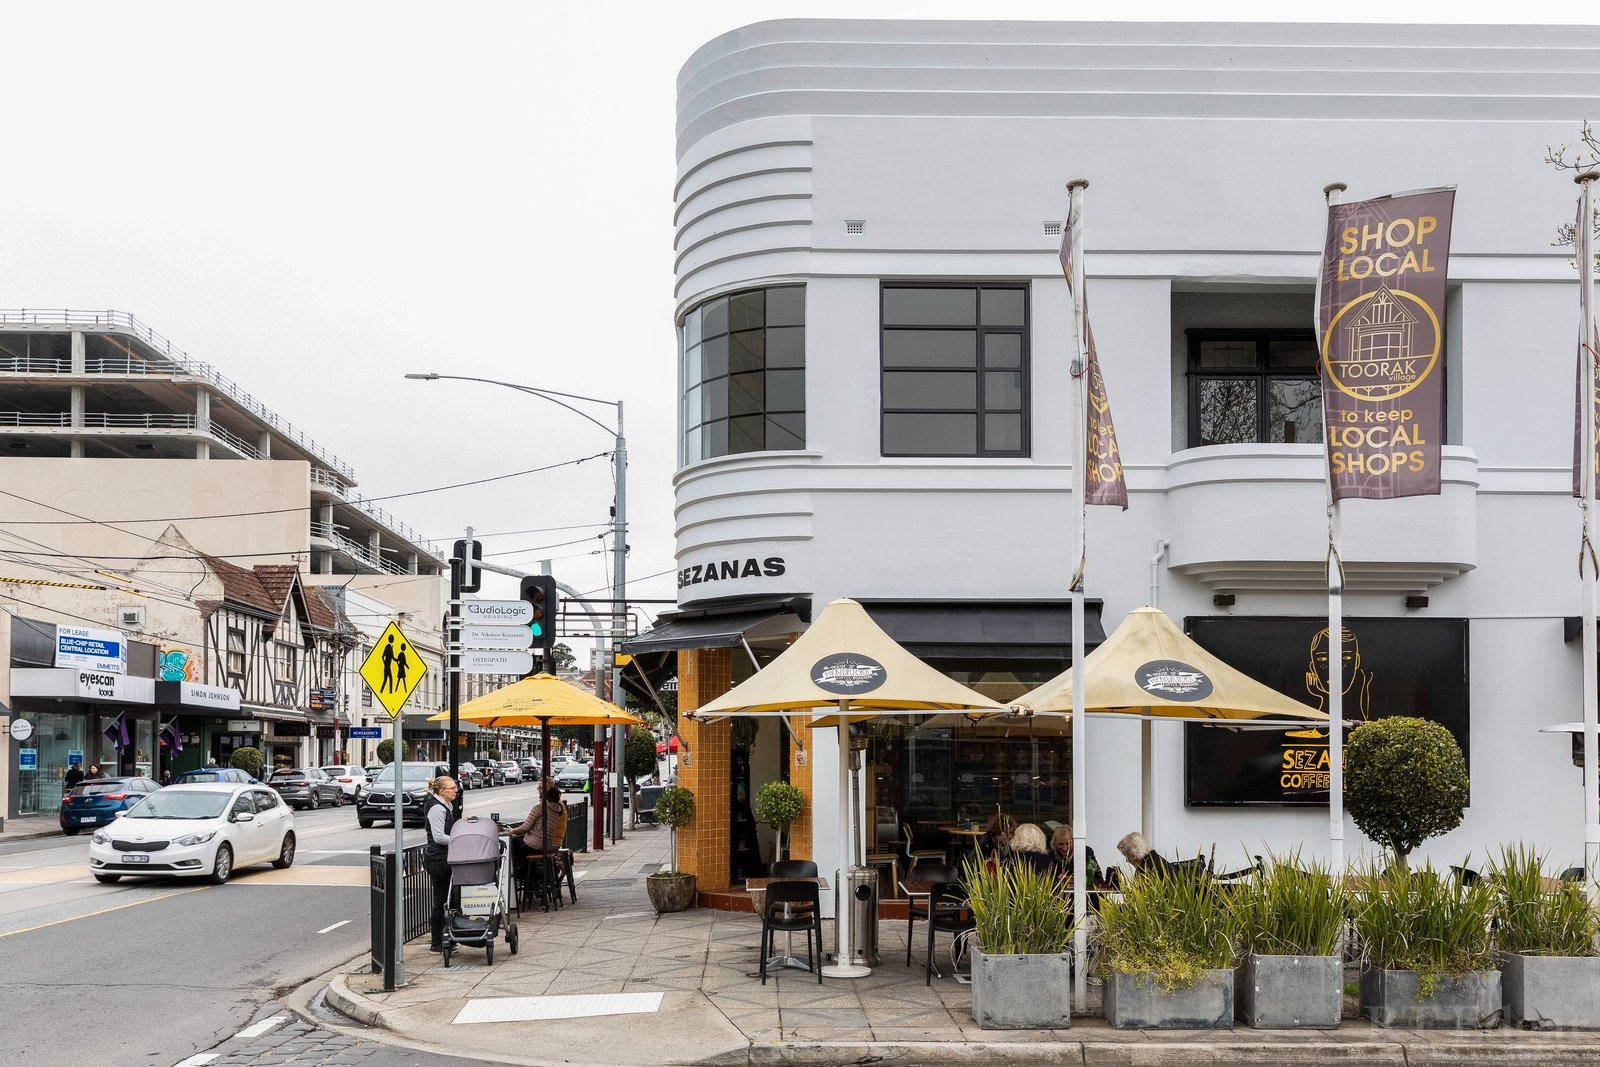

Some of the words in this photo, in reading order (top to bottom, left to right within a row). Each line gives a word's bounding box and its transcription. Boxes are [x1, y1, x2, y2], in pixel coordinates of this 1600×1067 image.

[1339, 215, 1438, 255] SHOP
[1337, 248, 1435, 282] LOCAL
[1339, 359, 1416, 379] TOORAK
[1388, 372, 1417, 383] village
[1340, 409, 1359, 423] to
[1364, 408, 1414, 424] keep
[1330, 423, 1426, 449] LOCAL
[1087, 461, 1122, 483] SHOP
[1331, 450, 1426, 476] SHOPS
[677, 557, 786, 590] SEZANAS
[60, 638, 88, 647] BLUE-CHIP
[88, 641, 105, 649] RETAIL
[60, 644, 84, 653] CENTRAL
[84, 647, 109, 655] LOCATION
[80, 672, 115, 687] eyescan
[190, 689, 207, 698] SIMON
[208, 692, 230, 701] JOHNSON
[1280, 773, 1331, 789] COFFEE
